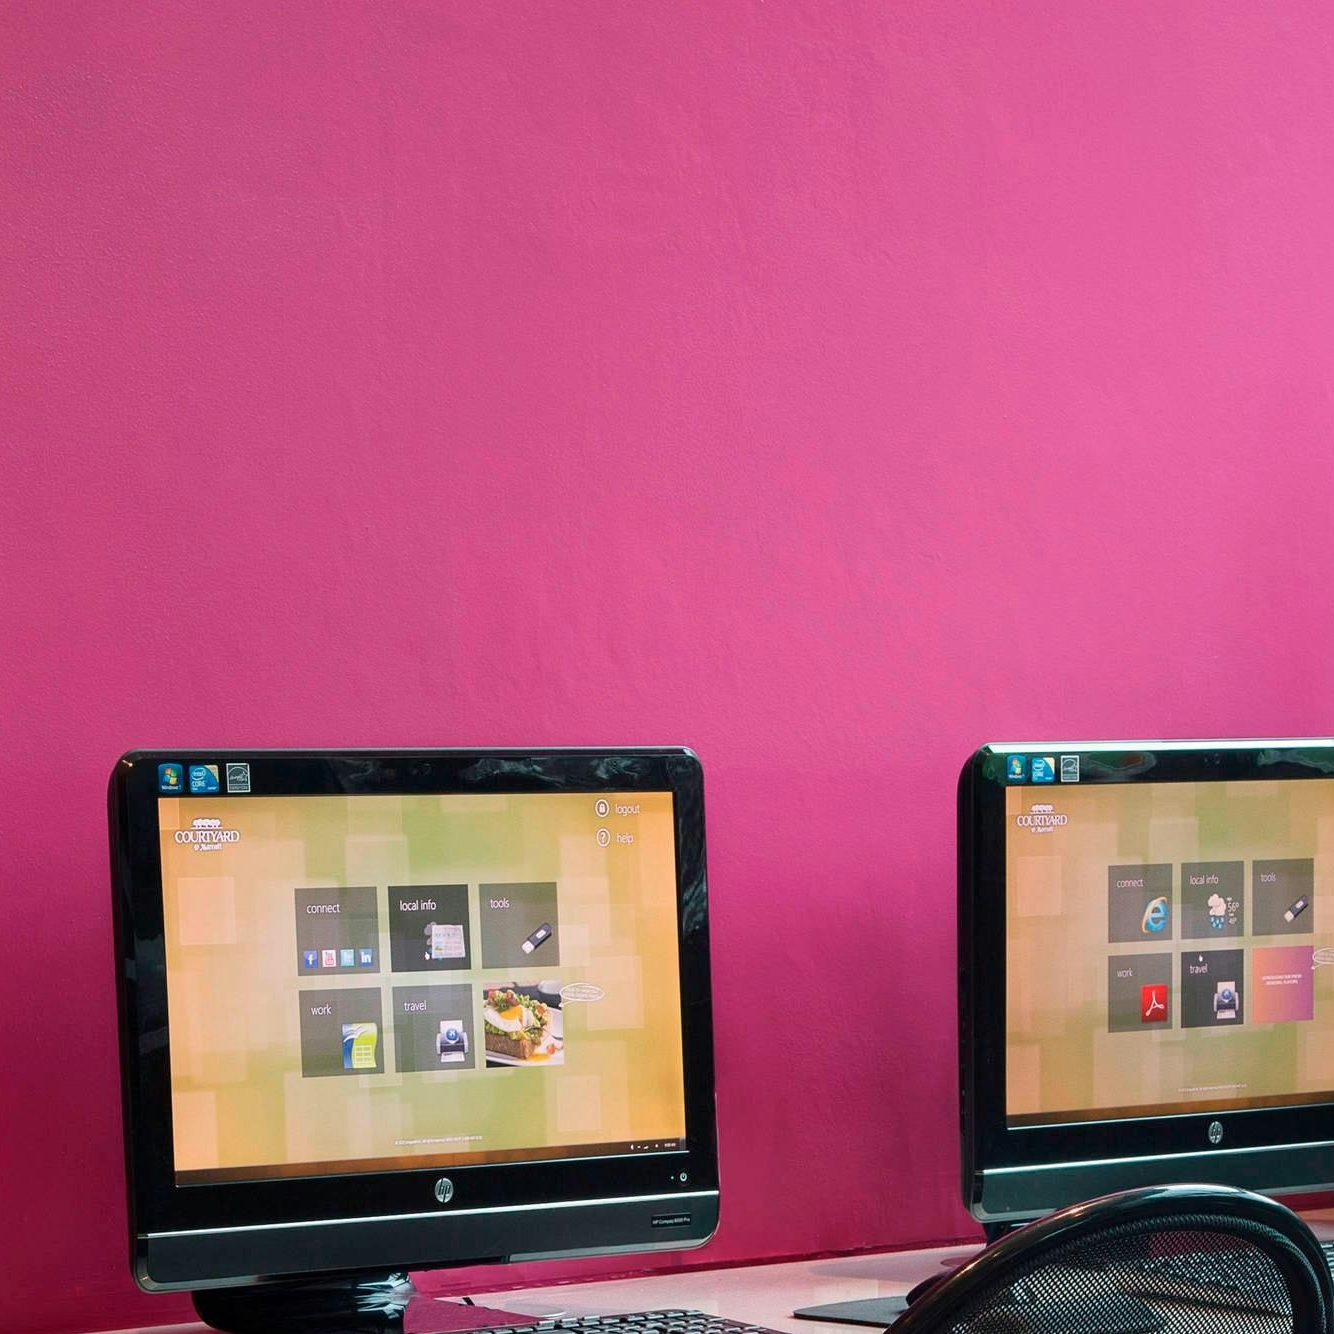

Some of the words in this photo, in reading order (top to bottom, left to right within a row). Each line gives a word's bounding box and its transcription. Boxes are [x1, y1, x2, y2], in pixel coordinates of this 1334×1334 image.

[615, 804, 640, 816] logout
[1017, 814, 1067, 826] COURTYARD
[175, 830, 240, 844] COURTYARD
[617, 832, 634, 845] help
[1116, 878, 1144, 888] connect
[1189, 874, 1205, 885] local
[1206, 874, 1220, 884] info
[1260, 873, 1277, 882] tools
[306, 903, 341, 914] connect
[399, 900, 419, 911] local
[420, 899, 437, 910] info
[490, 898, 510, 909] tools
[360, 951, 371, 963] in
[1116, 967, 1134, 977] work
[1189, 963, 1208, 974] travel
[311, 1005, 332, 1015] work
[404, 1000, 427, 1012] travel
[435, 1177, 454, 1203] hp
